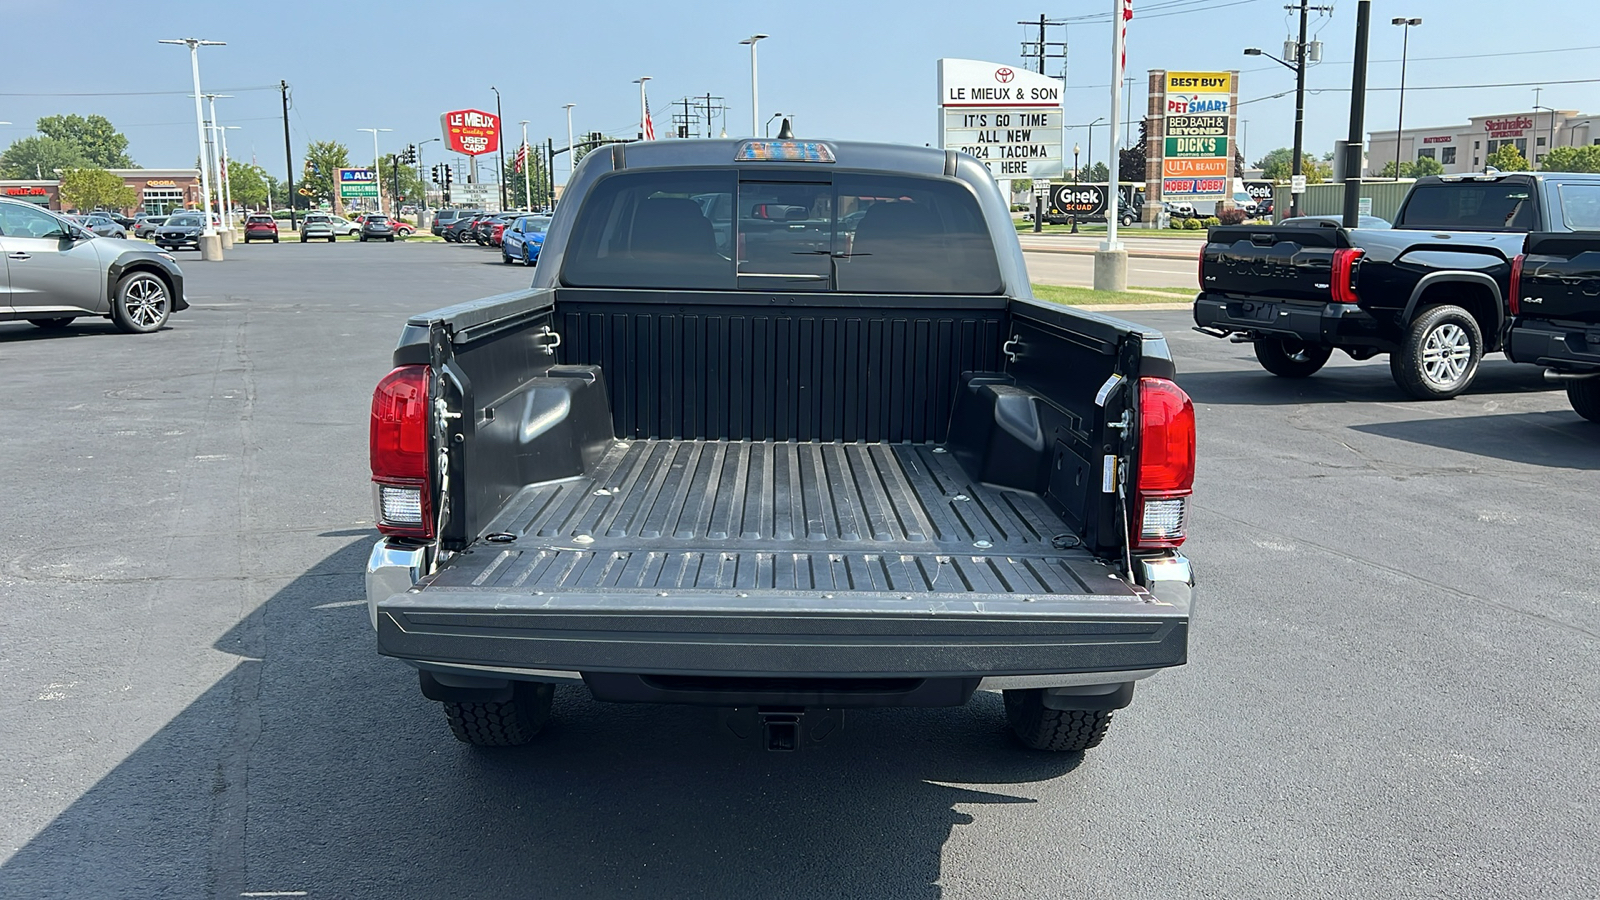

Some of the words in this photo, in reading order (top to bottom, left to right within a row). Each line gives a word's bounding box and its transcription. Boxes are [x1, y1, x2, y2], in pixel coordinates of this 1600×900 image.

[1171, 78, 1199, 87] BEST
[1201, 78, 1225, 87] BUY
[950, 88, 965, 100] LE
[971, 88, 1010, 100] MIEUX
[1016, 88, 1025, 100] &
[1031, 88, 1058, 100] SON
[450, 114, 463, 126] LE
[464, 112, 494, 128] MIEUX
[964, 114, 987, 127] IT'S
[996, 114, 1010, 127] GO
[1020, 113, 1048, 127] TIME
[1169, 117, 1188, 127] BED
[1190, 117, 1215, 127] BATH
[1216, 117, 1224, 127] &
[462, 128, 484, 136] Quality
[978, 130, 999, 143] ALL
[1007, 129, 1031, 142] NEW
[1169, 127, 1224, 135] BEYOND
[460, 136, 489, 145] USED
[1177, 138, 1216, 152] DICK'S
[463, 143, 486, 153] CARS
[1000, 145, 1047, 158] TACOMA
[1001, 161, 1028, 174] HERE
[1168, 161, 1193, 171] ULTA
[1195, 163, 1225, 171] BEAUTY
[1164, 180, 1194, 192] HOBBY
[1197, 179, 1225, 192] LOBBY
[1247, 185, 1271, 198] Geek
[1060, 189, 1099, 204] Geek
